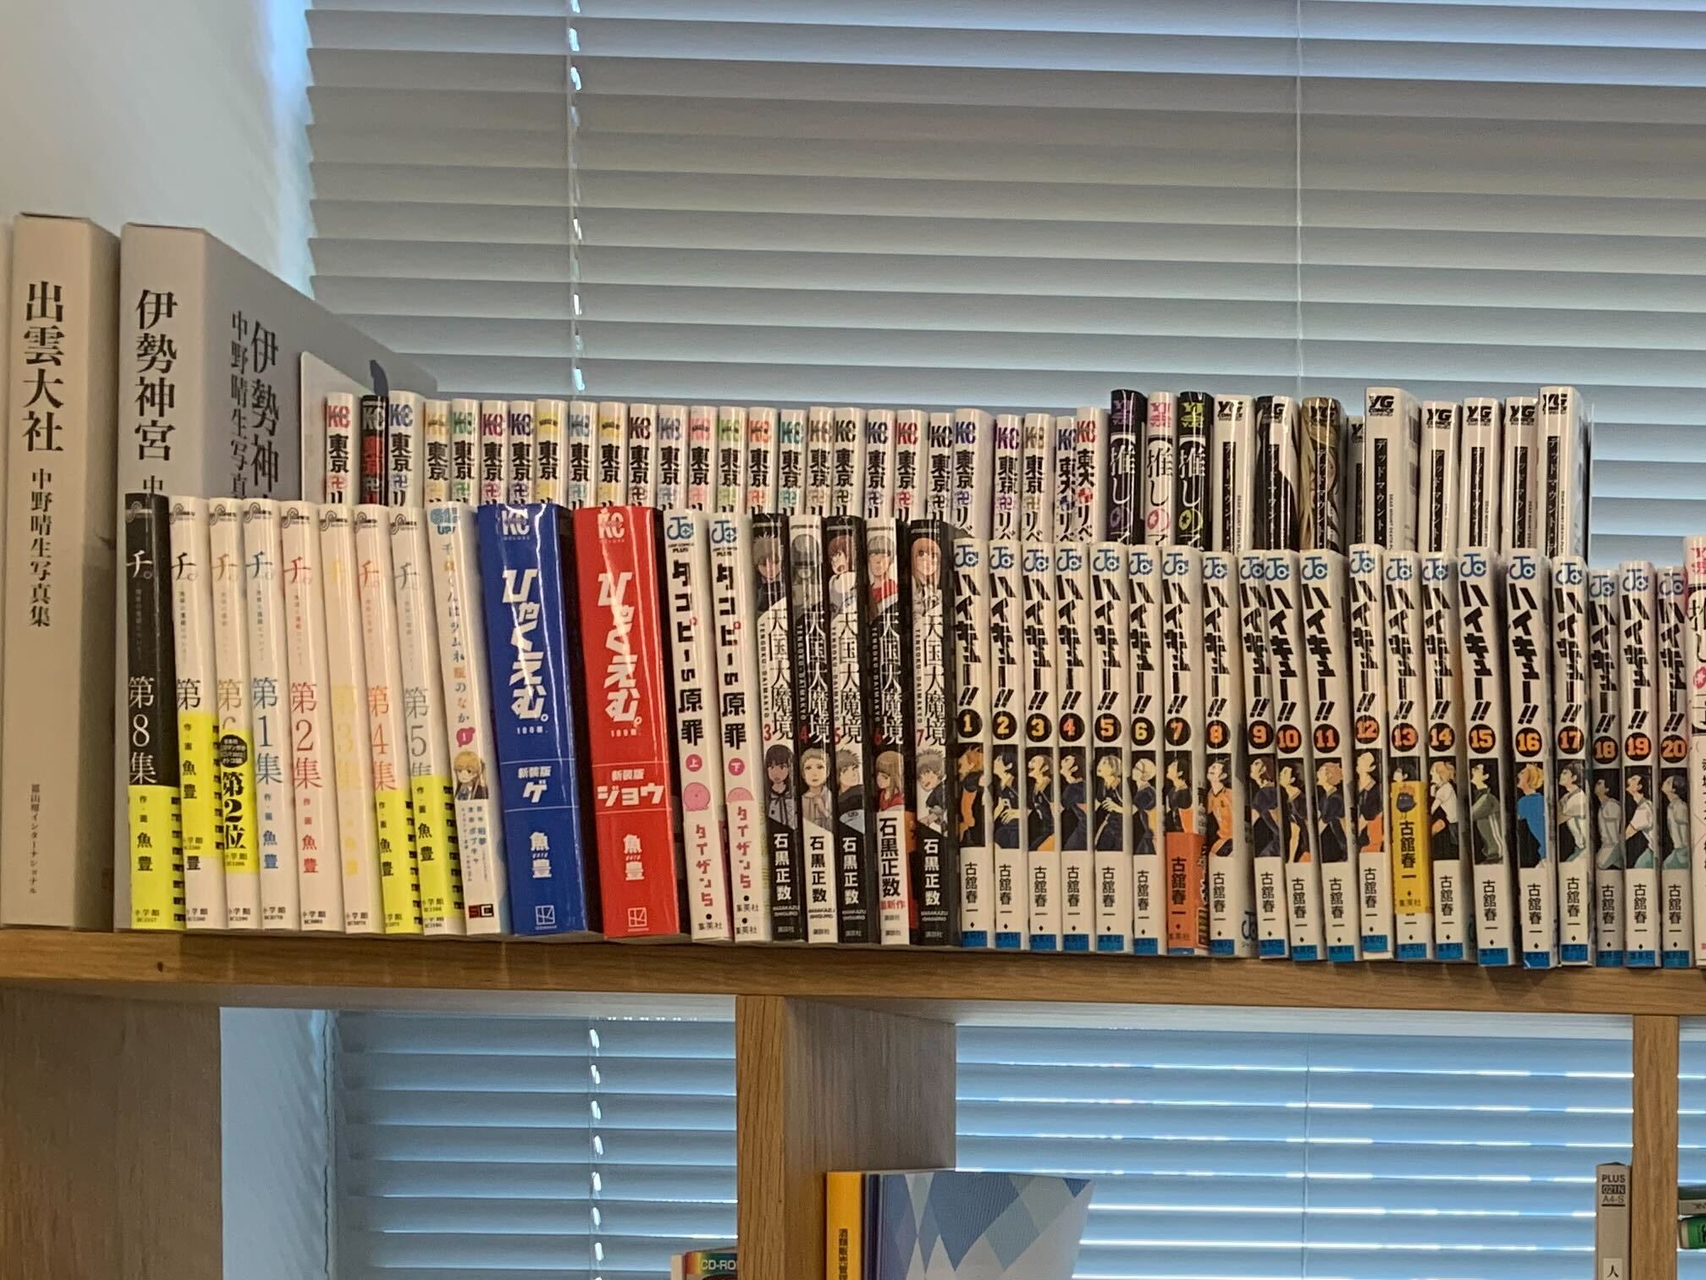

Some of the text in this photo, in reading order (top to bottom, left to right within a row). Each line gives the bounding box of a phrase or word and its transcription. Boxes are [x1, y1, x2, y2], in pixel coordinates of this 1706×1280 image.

[23, 280, 64, 453] 出雲大社
[135, 289, 177, 462] 伊勢神宮
[502, 569, 549, 724] ひゃくえむ。
[770, 608, 795, 742] 天国大魔境
[881, 610, 904, 746] 天国大魔境
[127, 677, 157, 785] 第8集
[252, 677, 282, 785] 第1集
[291, 682, 323, 789] 第2集
[222, 771, 246, 850] 第2位
[522, 781, 548, 804] ゲ
[596, 786, 664, 807] ジョウ
[137, 831, 153, 872] 魚豊
[773, 833, 791, 901] 石黒正数
[879, 817, 901, 898] 石黒正数
